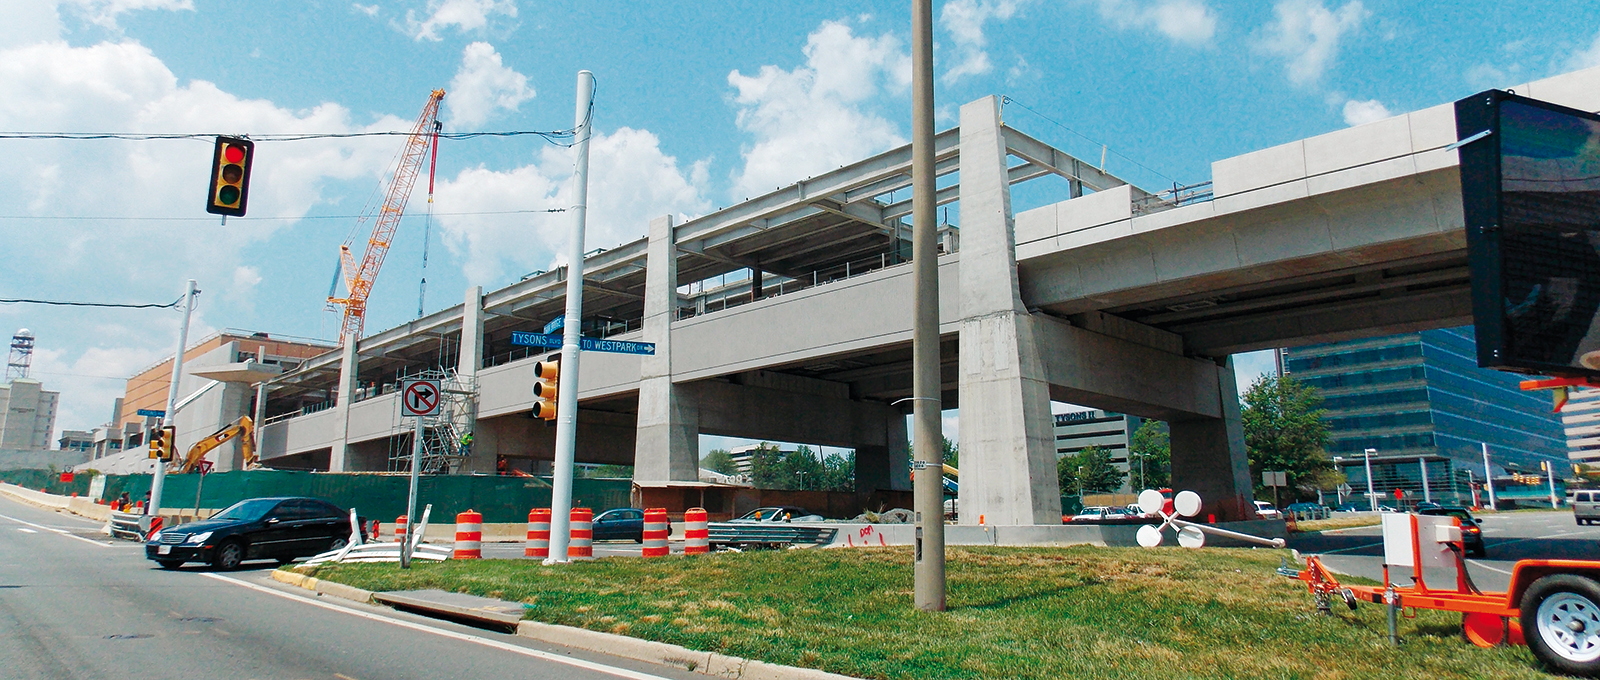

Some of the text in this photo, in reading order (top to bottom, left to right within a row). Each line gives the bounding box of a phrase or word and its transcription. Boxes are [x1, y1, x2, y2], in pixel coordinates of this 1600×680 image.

[512, 333, 547, 346] TYSONS
[583, 339, 592, 349] TO
[594, 340, 637, 352] WESTPARK
[1055, 411, 1087, 422] TYSONS
